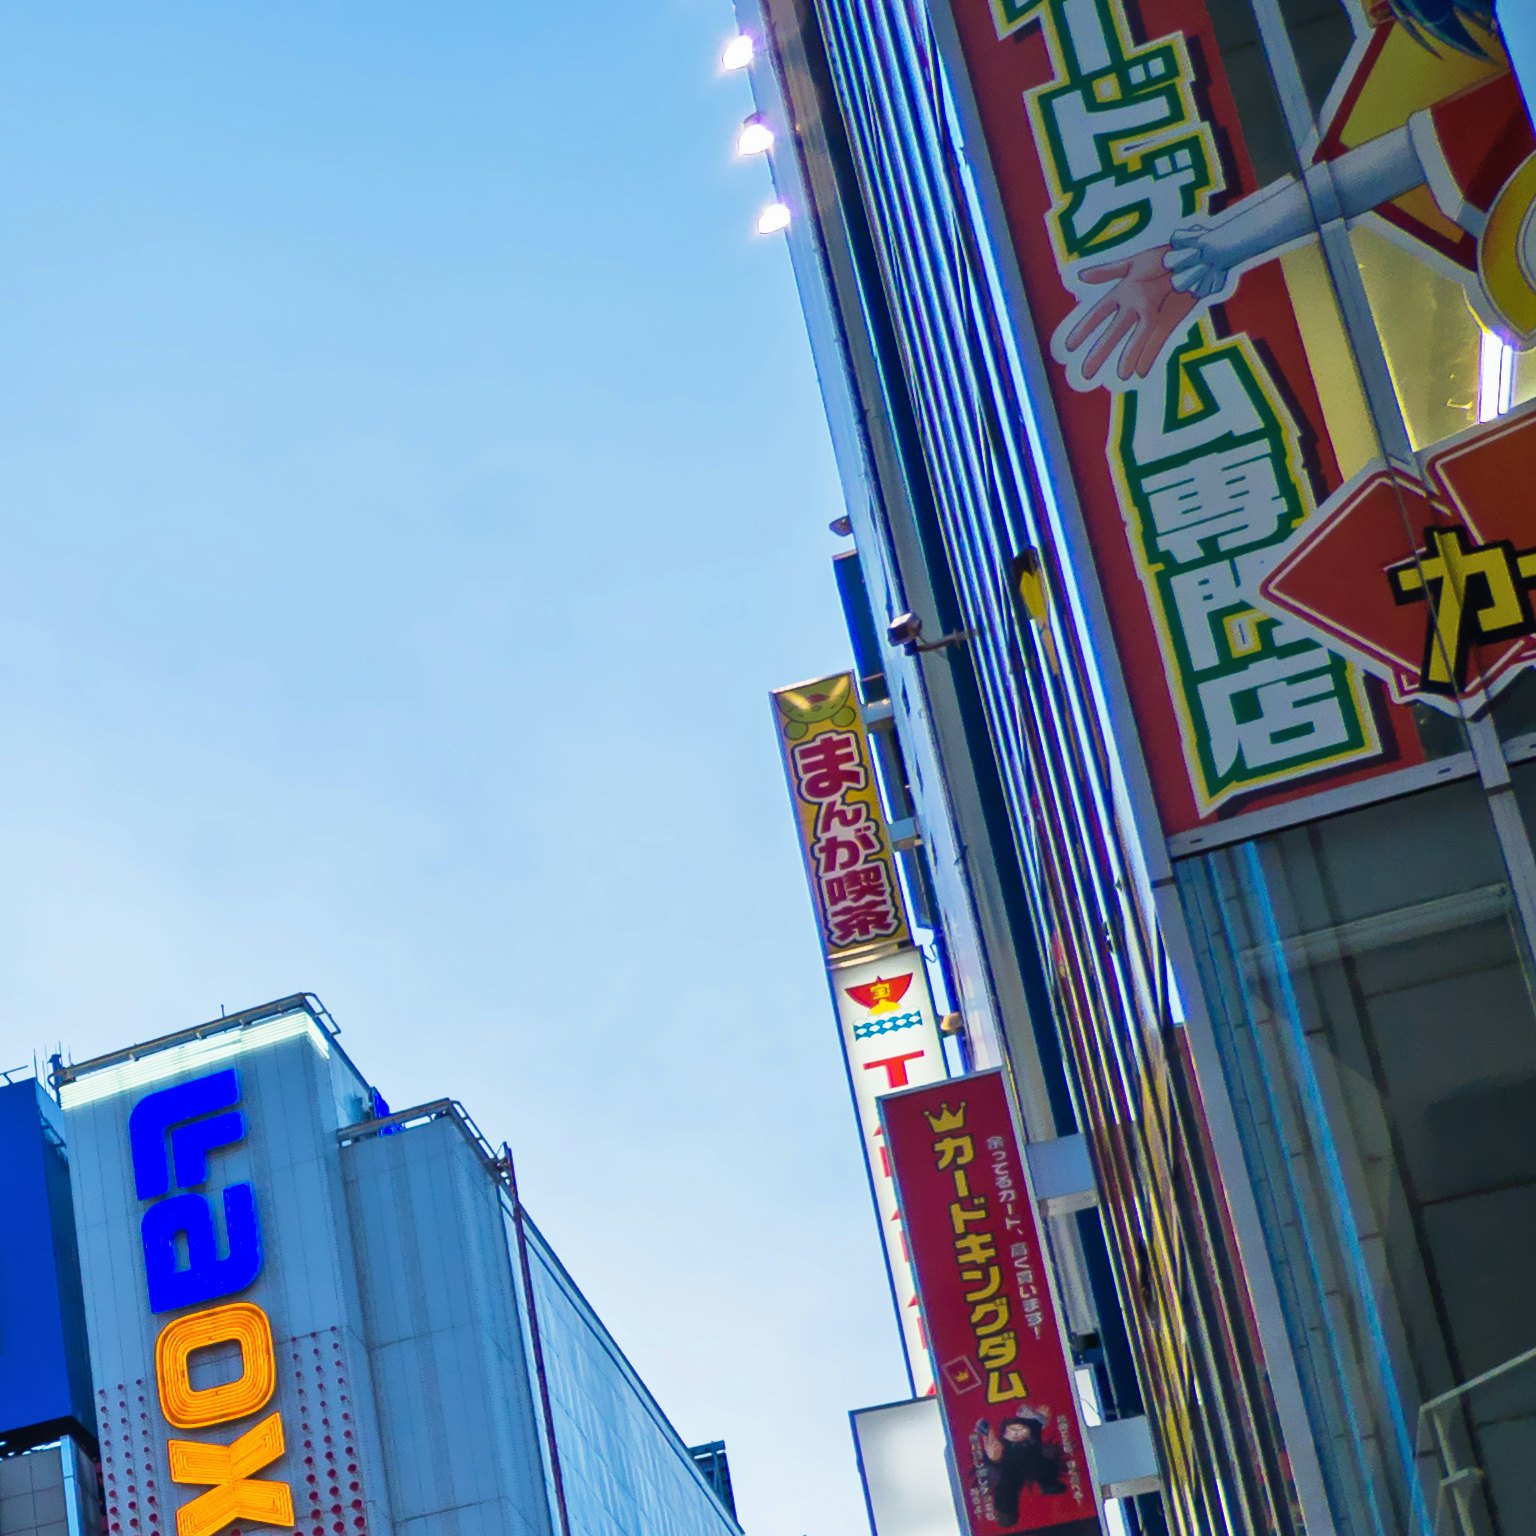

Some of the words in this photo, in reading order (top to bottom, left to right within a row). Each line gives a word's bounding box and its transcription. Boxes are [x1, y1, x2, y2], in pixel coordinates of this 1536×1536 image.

[795, 732, 901, 948] まんが喫茶
[933, 1139, 1027, 1404] カードキングダム
